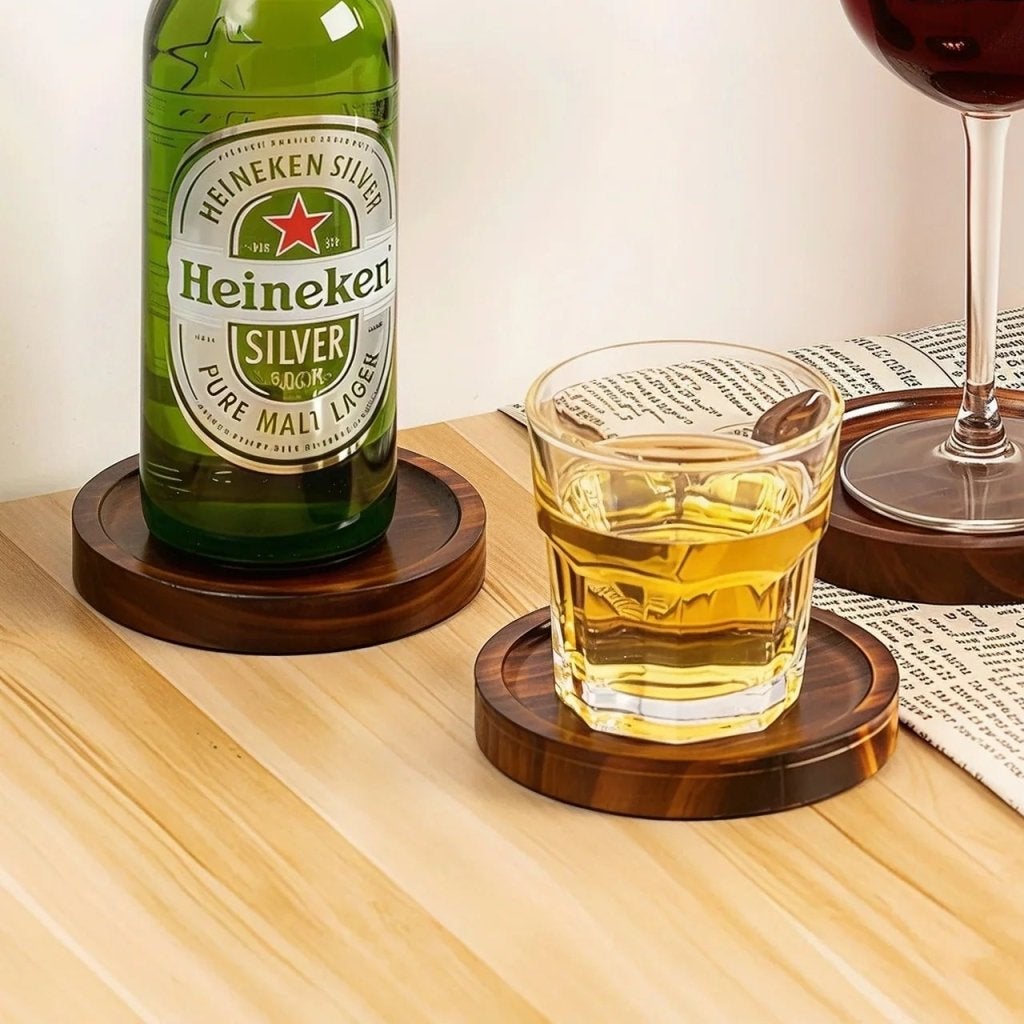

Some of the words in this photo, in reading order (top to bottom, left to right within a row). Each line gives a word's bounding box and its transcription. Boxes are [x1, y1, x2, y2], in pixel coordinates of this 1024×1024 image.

[198, 153, 324, 225] HEINEKEN
[330, 154, 382, 215] SILVER
[179, 255, 391, 312] Heineken
[244, 325, 345, 366] SILVER
[198, 363, 250, 423] PURE
